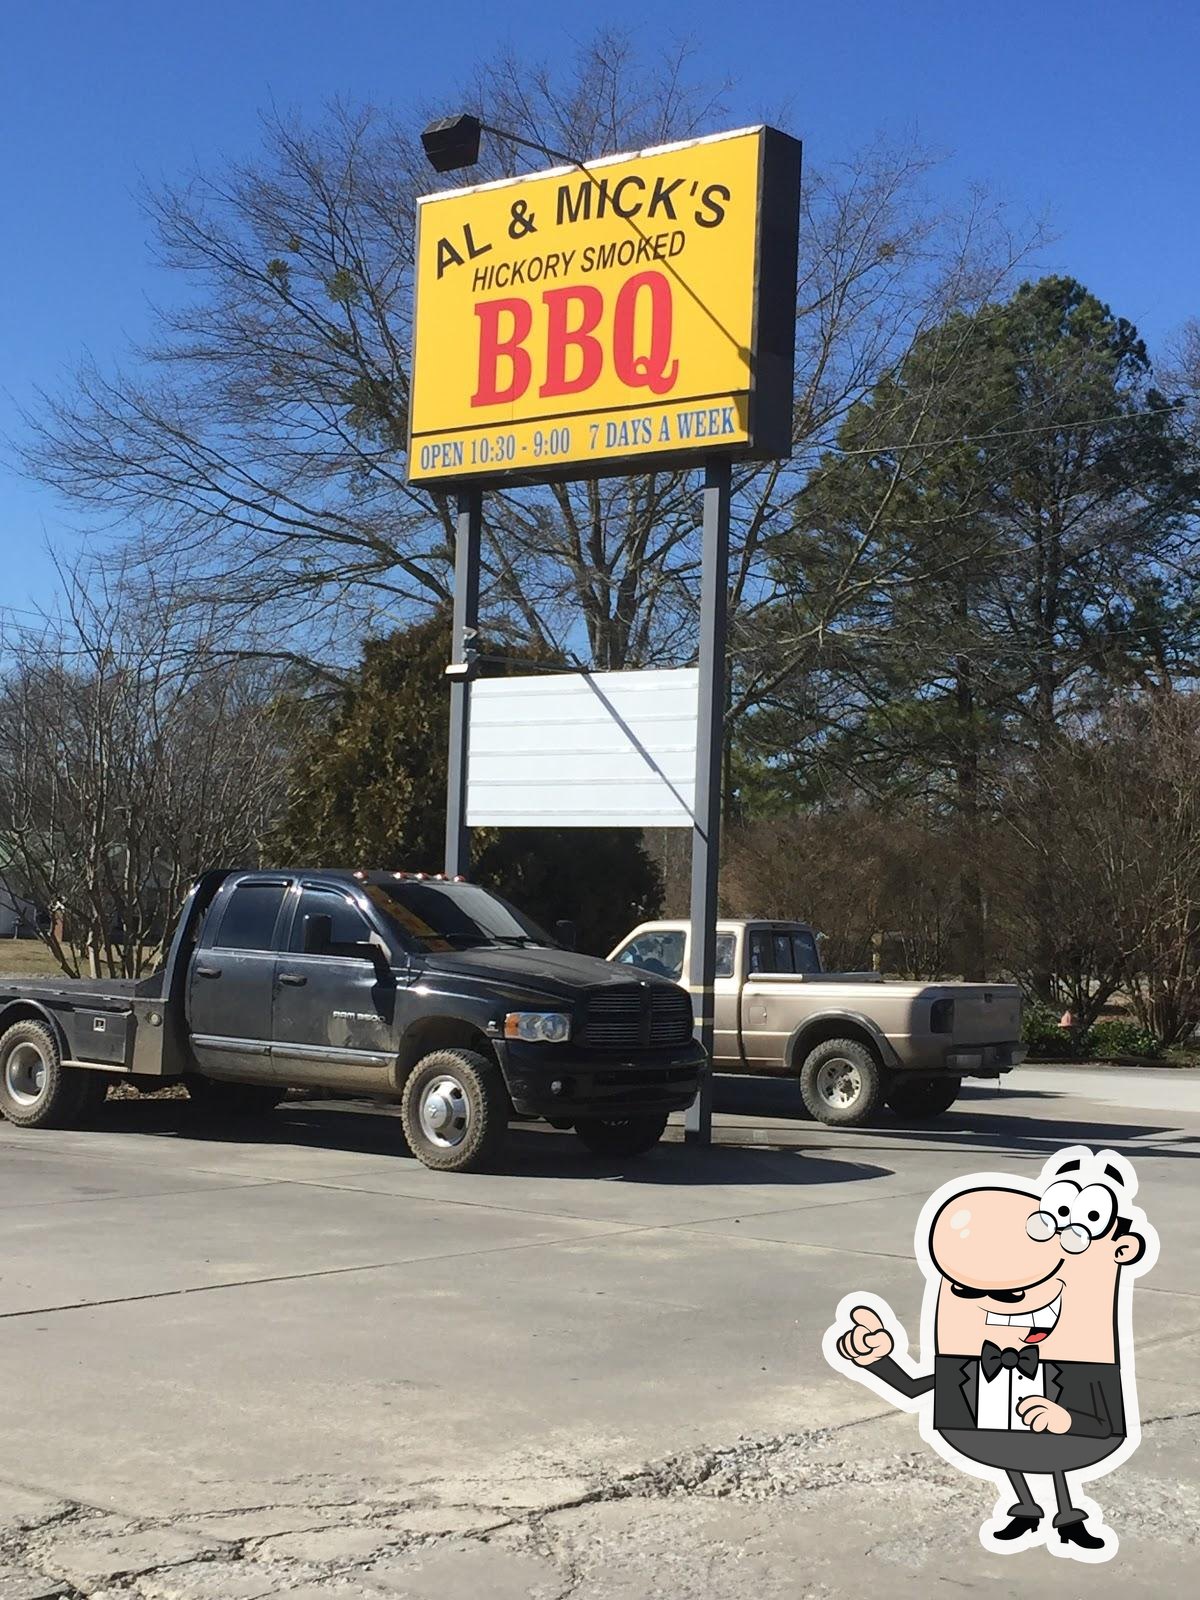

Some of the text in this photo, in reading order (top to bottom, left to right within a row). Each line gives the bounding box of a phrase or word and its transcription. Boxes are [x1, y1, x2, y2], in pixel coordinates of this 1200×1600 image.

[437, 175, 731, 280] AL & MICK'S
[472, 230, 685, 292] HICKORY SMOKED
[470, 270, 679, 408] BBQ
[420, 440, 465, 470] OPEN
[471, 434, 516, 465] 10:30
[533, 427, 571, 457] 9:00
[589, 424, 600, 450] 7
[605, 417, 653, 448] DAYS
[658, 415, 671, 442] A
[677, 406, 736, 439] WEEK
